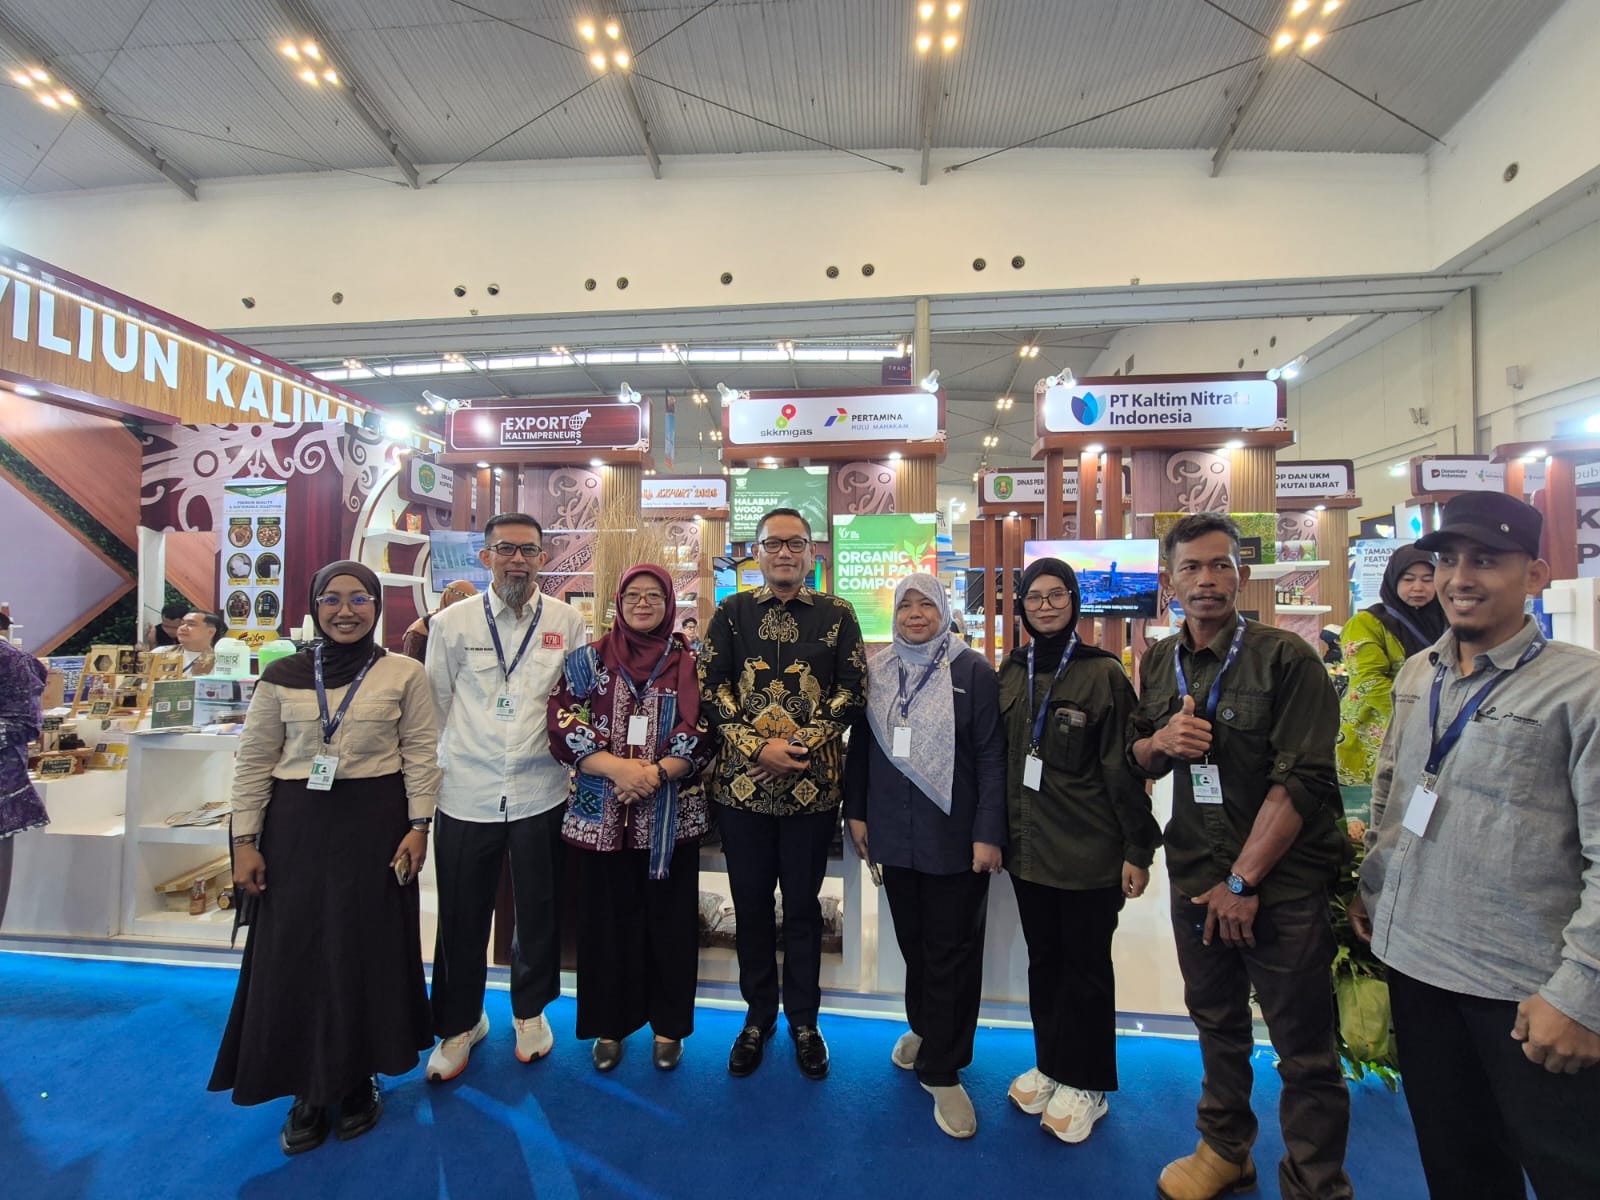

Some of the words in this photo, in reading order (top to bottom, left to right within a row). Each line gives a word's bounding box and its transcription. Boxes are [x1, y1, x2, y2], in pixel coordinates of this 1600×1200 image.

[1110, 394, 1129, 408] PT
[1132, 392, 1187, 408] Kaltim
[851, 413, 903, 422] PERTAMINA
[1110, 409, 1192, 425] Indonesia
[505, 416, 570, 430] EXPORT
[505, 431, 581, 440] KALTIMPRENEURS
[760, 428, 813, 438] skkmigas
[1309, 472, 1330, 480] UKM
[1309, 481, 1340, 489] BARAT
[734, 497, 778, 506] HALABAN
[838, 551, 909, 564] ORGANIC
[838, 564, 884, 577] NIPAH
